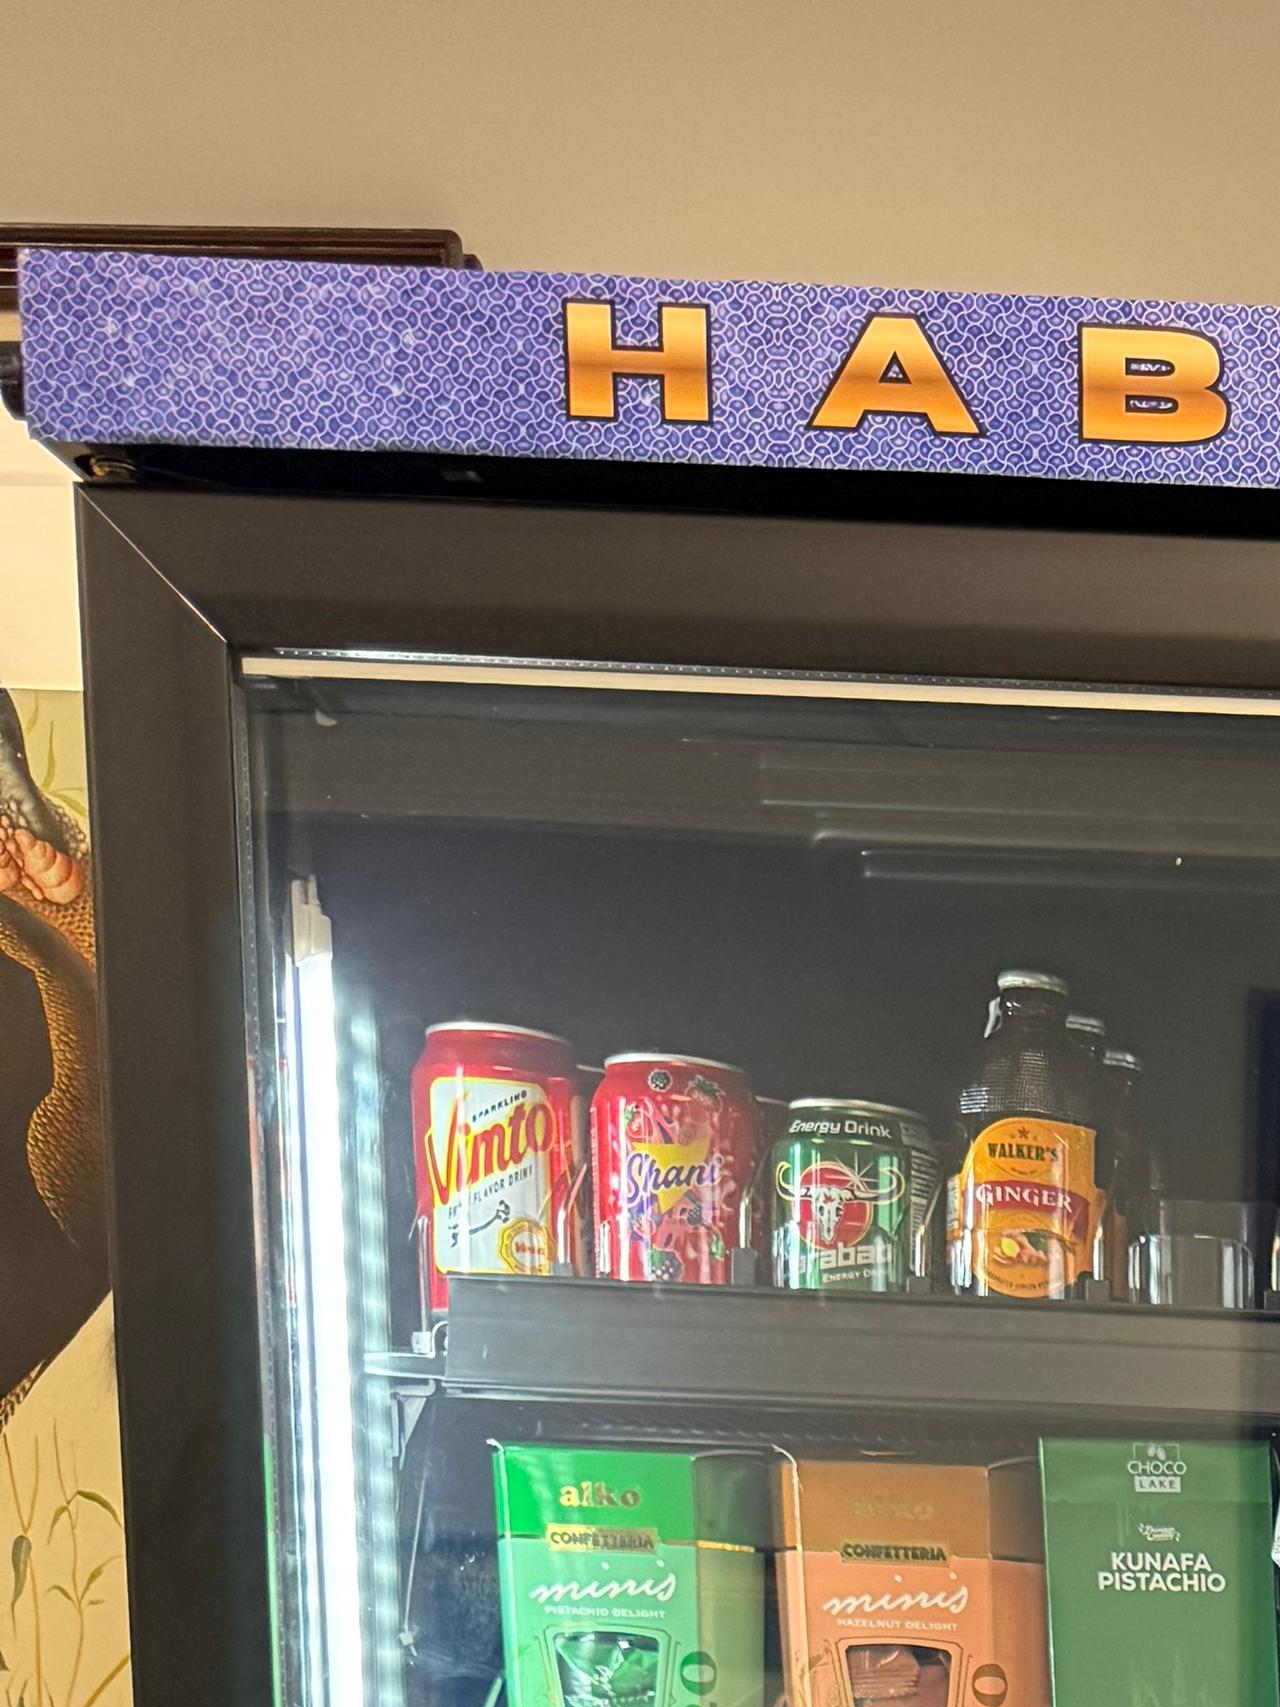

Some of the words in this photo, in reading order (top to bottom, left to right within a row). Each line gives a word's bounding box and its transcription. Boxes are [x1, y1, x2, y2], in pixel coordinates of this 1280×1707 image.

[472, 1090, 527, 1122] SPARKLING
[789, 1120, 840, 1137] Energy
[844, 1121, 892, 1139] Drink
[427, 1101, 553, 1205] Vimto
[988, 1143, 1058, 1162] WALKER'S
[626, 1150, 725, 1208] Shani
[975, 1184, 1073, 1213] GINGER
[1127, 1460, 1187, 1476] CHOCO
[1138, 1478, 1178, 1490] LAKE
[560, 1481, 641, 1509] alko
[843, 1542, 947, 1562] CONFETTERIA
[1110, 1552, 1212, 1572] KUNAFA
[530, 1559, 677, 1602] minis
[1098, 1572, 1226, 1593] PISTACHIO
[822, 1573, 969, 1615] minis
[545, 1606, 610, 1618] PISTACHIO
[612, 1607, 666, 1619] DELIGHT
[837, 1618, 901, 1630] HAZELNUT
[906, 1620, 959, 1632] DELIGHT
